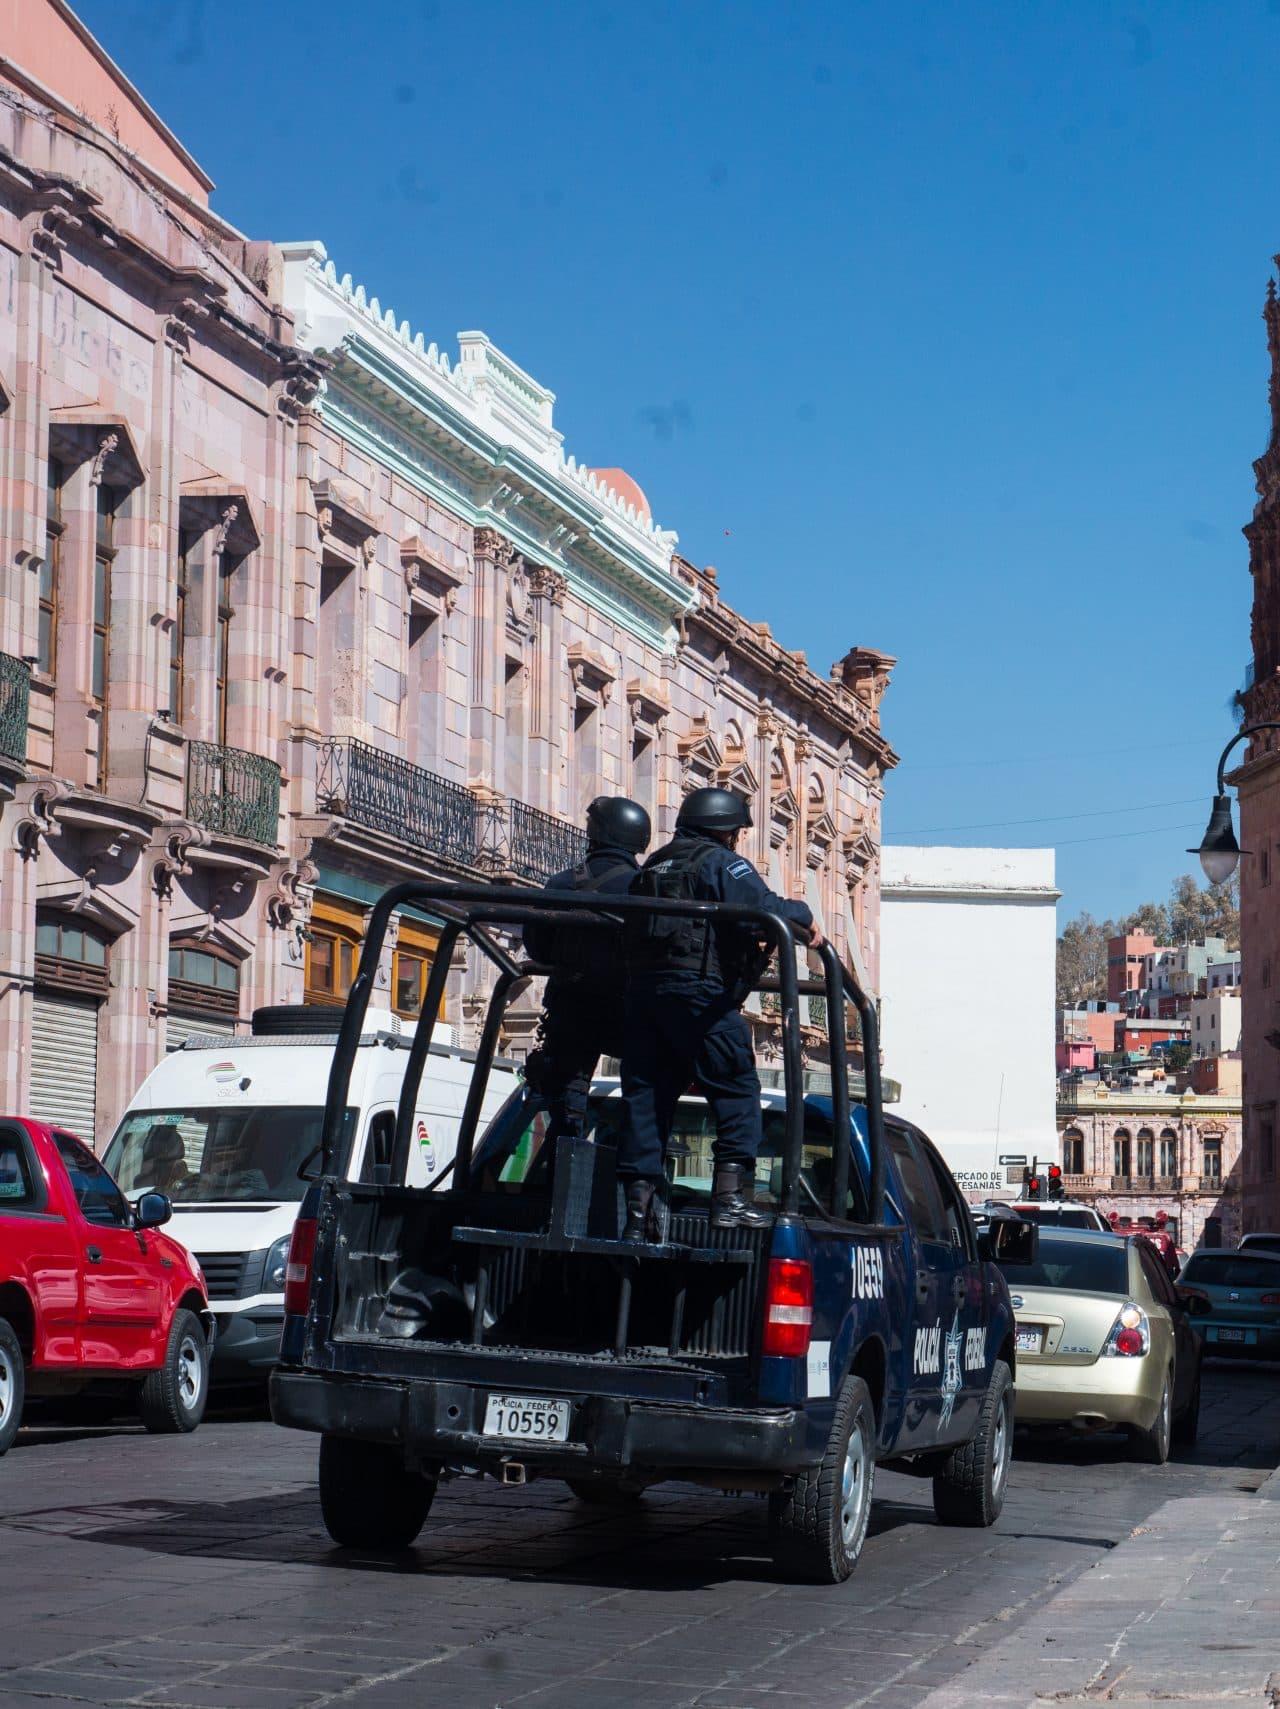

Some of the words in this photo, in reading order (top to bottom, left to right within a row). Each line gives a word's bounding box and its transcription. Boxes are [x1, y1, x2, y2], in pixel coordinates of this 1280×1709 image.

[952, 1172, 989, 1181] ERCADO
[991, 1172, 1003, 1181] DE
[957, 1181, 1002, 1190] ESANIAS
[851, 1246, 884, 1299] 10559
[965, 1327, 987, 1371] FEDERAL
[527, 1402, 563, 1412] FEDERAL
[497, 1410, 559, 1435] 10559
